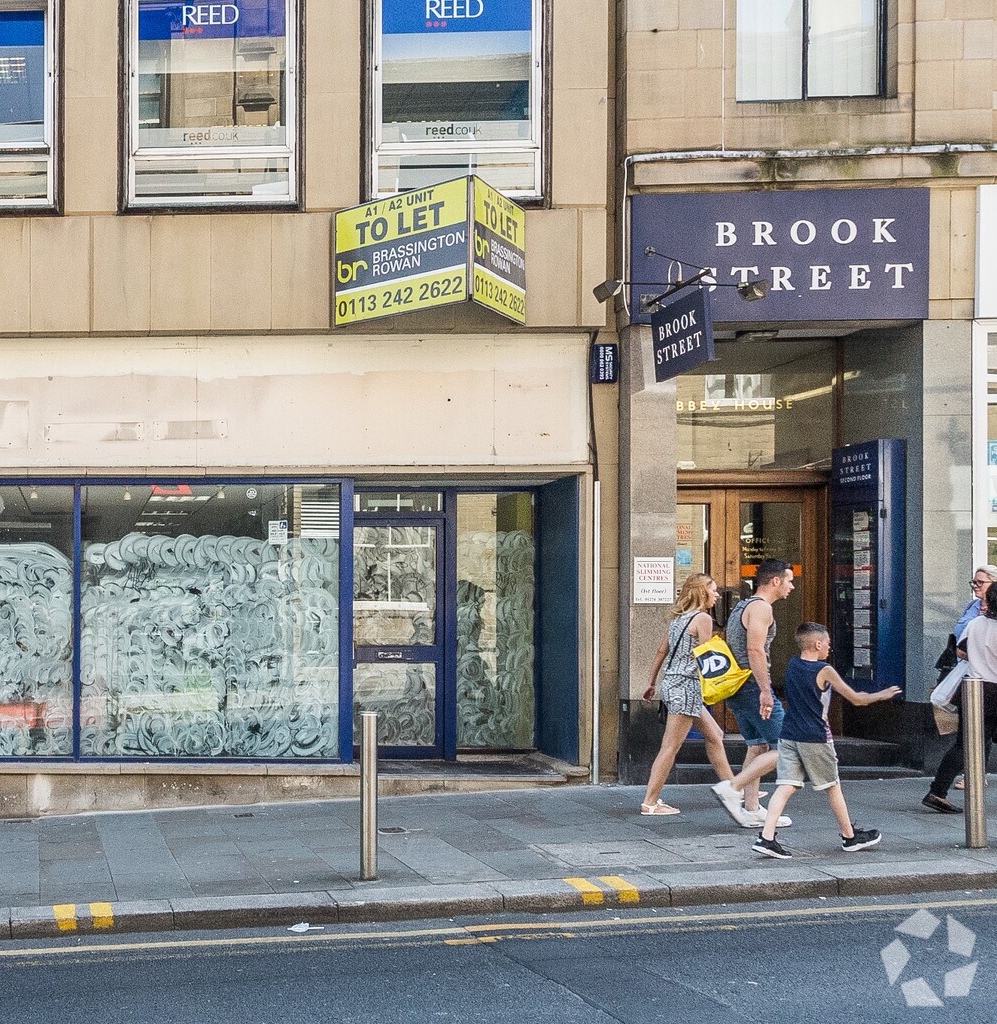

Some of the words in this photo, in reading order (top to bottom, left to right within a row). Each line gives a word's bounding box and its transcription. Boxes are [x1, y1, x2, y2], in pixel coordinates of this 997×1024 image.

[182, 4, 240, 25] REED
[366, 206, 377, 218] A1
[389, 199, 402, 211] A2
[407, 190, 434, 206] UNIT
[356, 217, 388, 244] TO
[398, 201, 444, 235] LET
[484, 200, 497, 229] TO
[500, 212, 518, 243] LET
[715, 218, 897, 247] BROOK
[373, 230, 465, 264] BRASSINGTON
[475, 229, 490, 260] br
[491, 239, 524, 270] BRASSINGTON
[337, 260, 368, 283] br
[373, 255, 421, 276] ROWAN
[491, 253, 510, 274] ROWAN
[698, 263, 914, 292] STREET
[339, 295, 376, 317] 0113
[383, 287, 413, 308] 242
[419, 276, 462, 301] 2622
[476, 275, 492, 300] 0113
[495, 284, 507, 306] 242
[509, 293, 524, 316] 2622
[658, 309, 697, 341] BROOK
[605, 346, 613, 362] MS
[656, 330, 702, 365] STREET
[676, 400, 721, 411] BBEY
[734, 399, 793, 411] HOUSE
[840, 463, 871, 475] STREET
[842, 452, 869, 463] BROOK
[701, 655, 727, 676] JD
